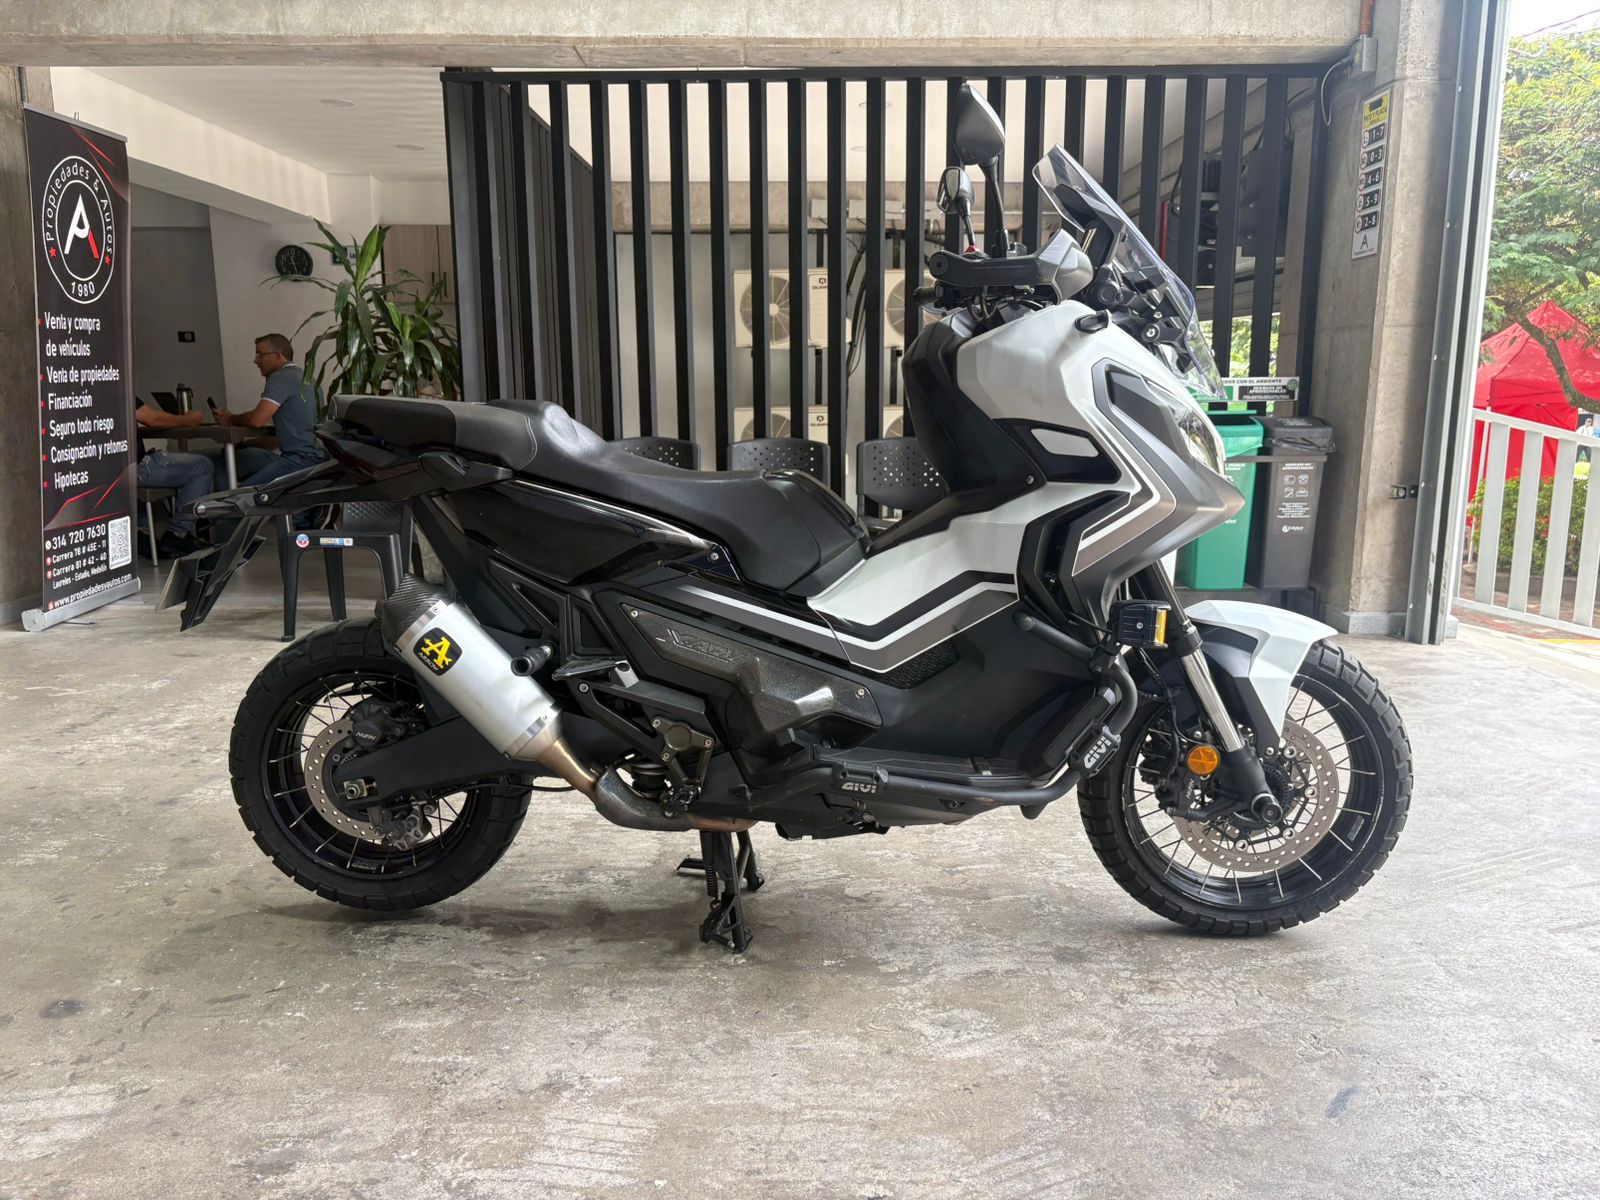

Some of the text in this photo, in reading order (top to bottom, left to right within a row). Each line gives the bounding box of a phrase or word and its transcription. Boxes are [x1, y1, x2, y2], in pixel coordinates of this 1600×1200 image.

[46, 162, 90, 241] Propiedades
[100, 199, 113, 254] Autos
[71, 281, 95, 297] 1980
[44, 312, 100, 335] Venta y compra
[46, 337, 90, 357] de vehículos
[46, 364, 119, 387] Venta de propiedades
[48, 388, 92, 410] Financiación
[50, 416, 114, 440] Seguro todo riesgo
[51, 439, 128, 465] Consignación y retomas
[54, 470, 89, 492] Hipotecas
[52, 524, 106, 550] 314 720 7630
[52, 551, 73, 564] Carrera
[52, 564, 74, 576] Carrera
[53, 577, 71, 589] Laureles
[1084, 736, 1111, 768] GIVI
[842, 782, 877, 793] GIVI
